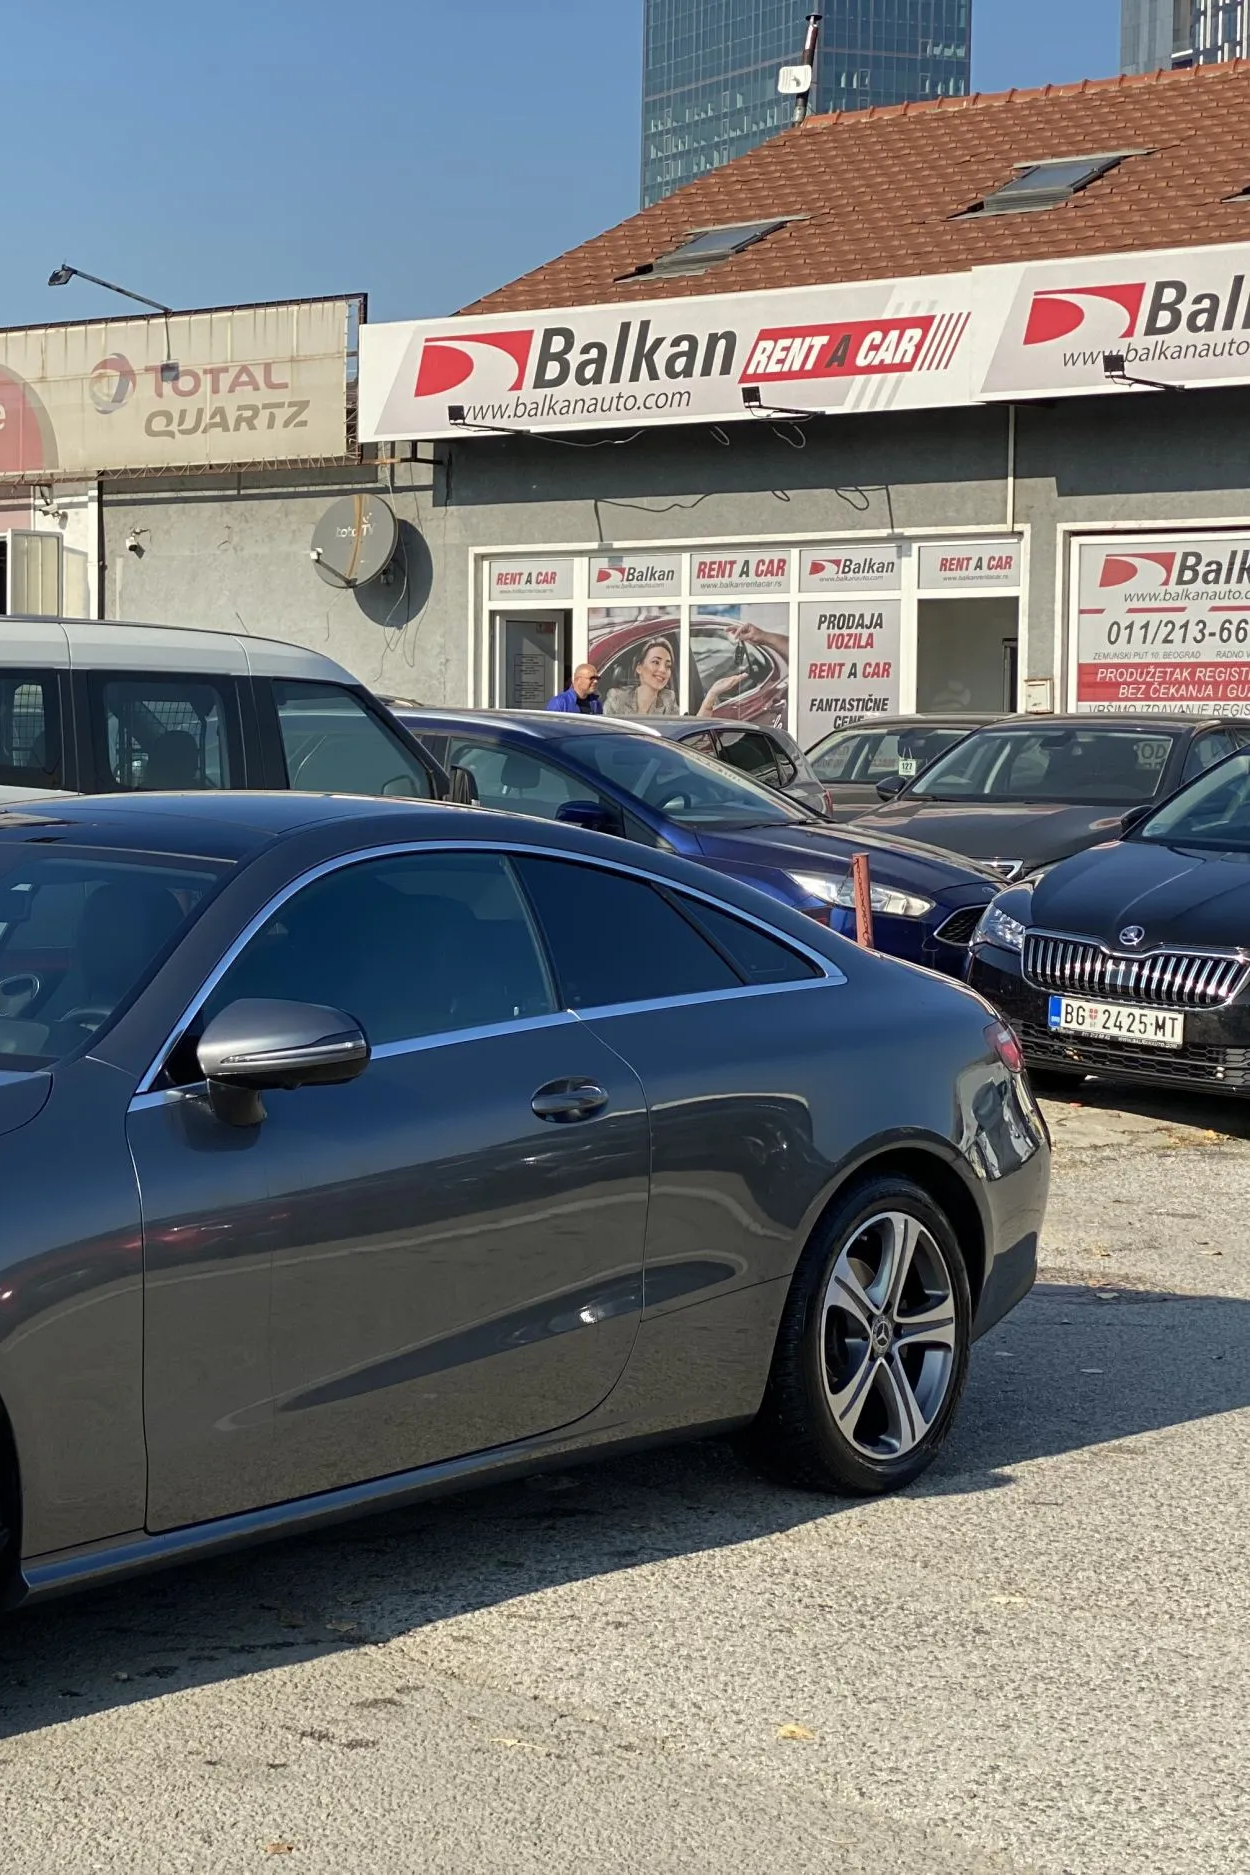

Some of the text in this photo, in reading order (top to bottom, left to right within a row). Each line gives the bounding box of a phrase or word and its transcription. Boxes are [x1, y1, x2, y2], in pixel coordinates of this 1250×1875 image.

[533, 319, 737, 390] Balkan
[747, 327, 924, 375] RENT A CAR
[144, 362, 289, 398] TOTAL
[144, 400, 310, 440] QUARTZ
[696, 558, 787, 579] RENT A CAR
[841, 558, 895, 575] Balkan
[939, 555, 1013, 572] RENT A CAR
[496, 571, 558, 587] RENT A CAR
[626, 566, 675, 582] Balkan
[700, 580, 782, 590] www.balkanrentacar.rs
[817, 613, 883, 631] PRODAJA
[1107, 618, 1249, 645] 011/213-66
[826, 632, 874, 650] VOZILA
[1093, 651, 1131, 660] ZEMUNSKI
[1133, 651, 1149, 660] PUT
[1162, 650, 1200, 660] BEOGRAD
[1216, 650, 1244, 659] RADNO
[808, 662, 892, 680] RENT A CAR
[1096, 665, 1191, 682] PRODUŽETAK
[1118, 684, 1145, 698] BEZ
[1150, 681, 1213, 698] ČEKANJA
[1218, 684, 1223, 698] I
[809, 694, 889, 712] FANTASTIČNE
[1064, 1003, 1086, 1026] BG
